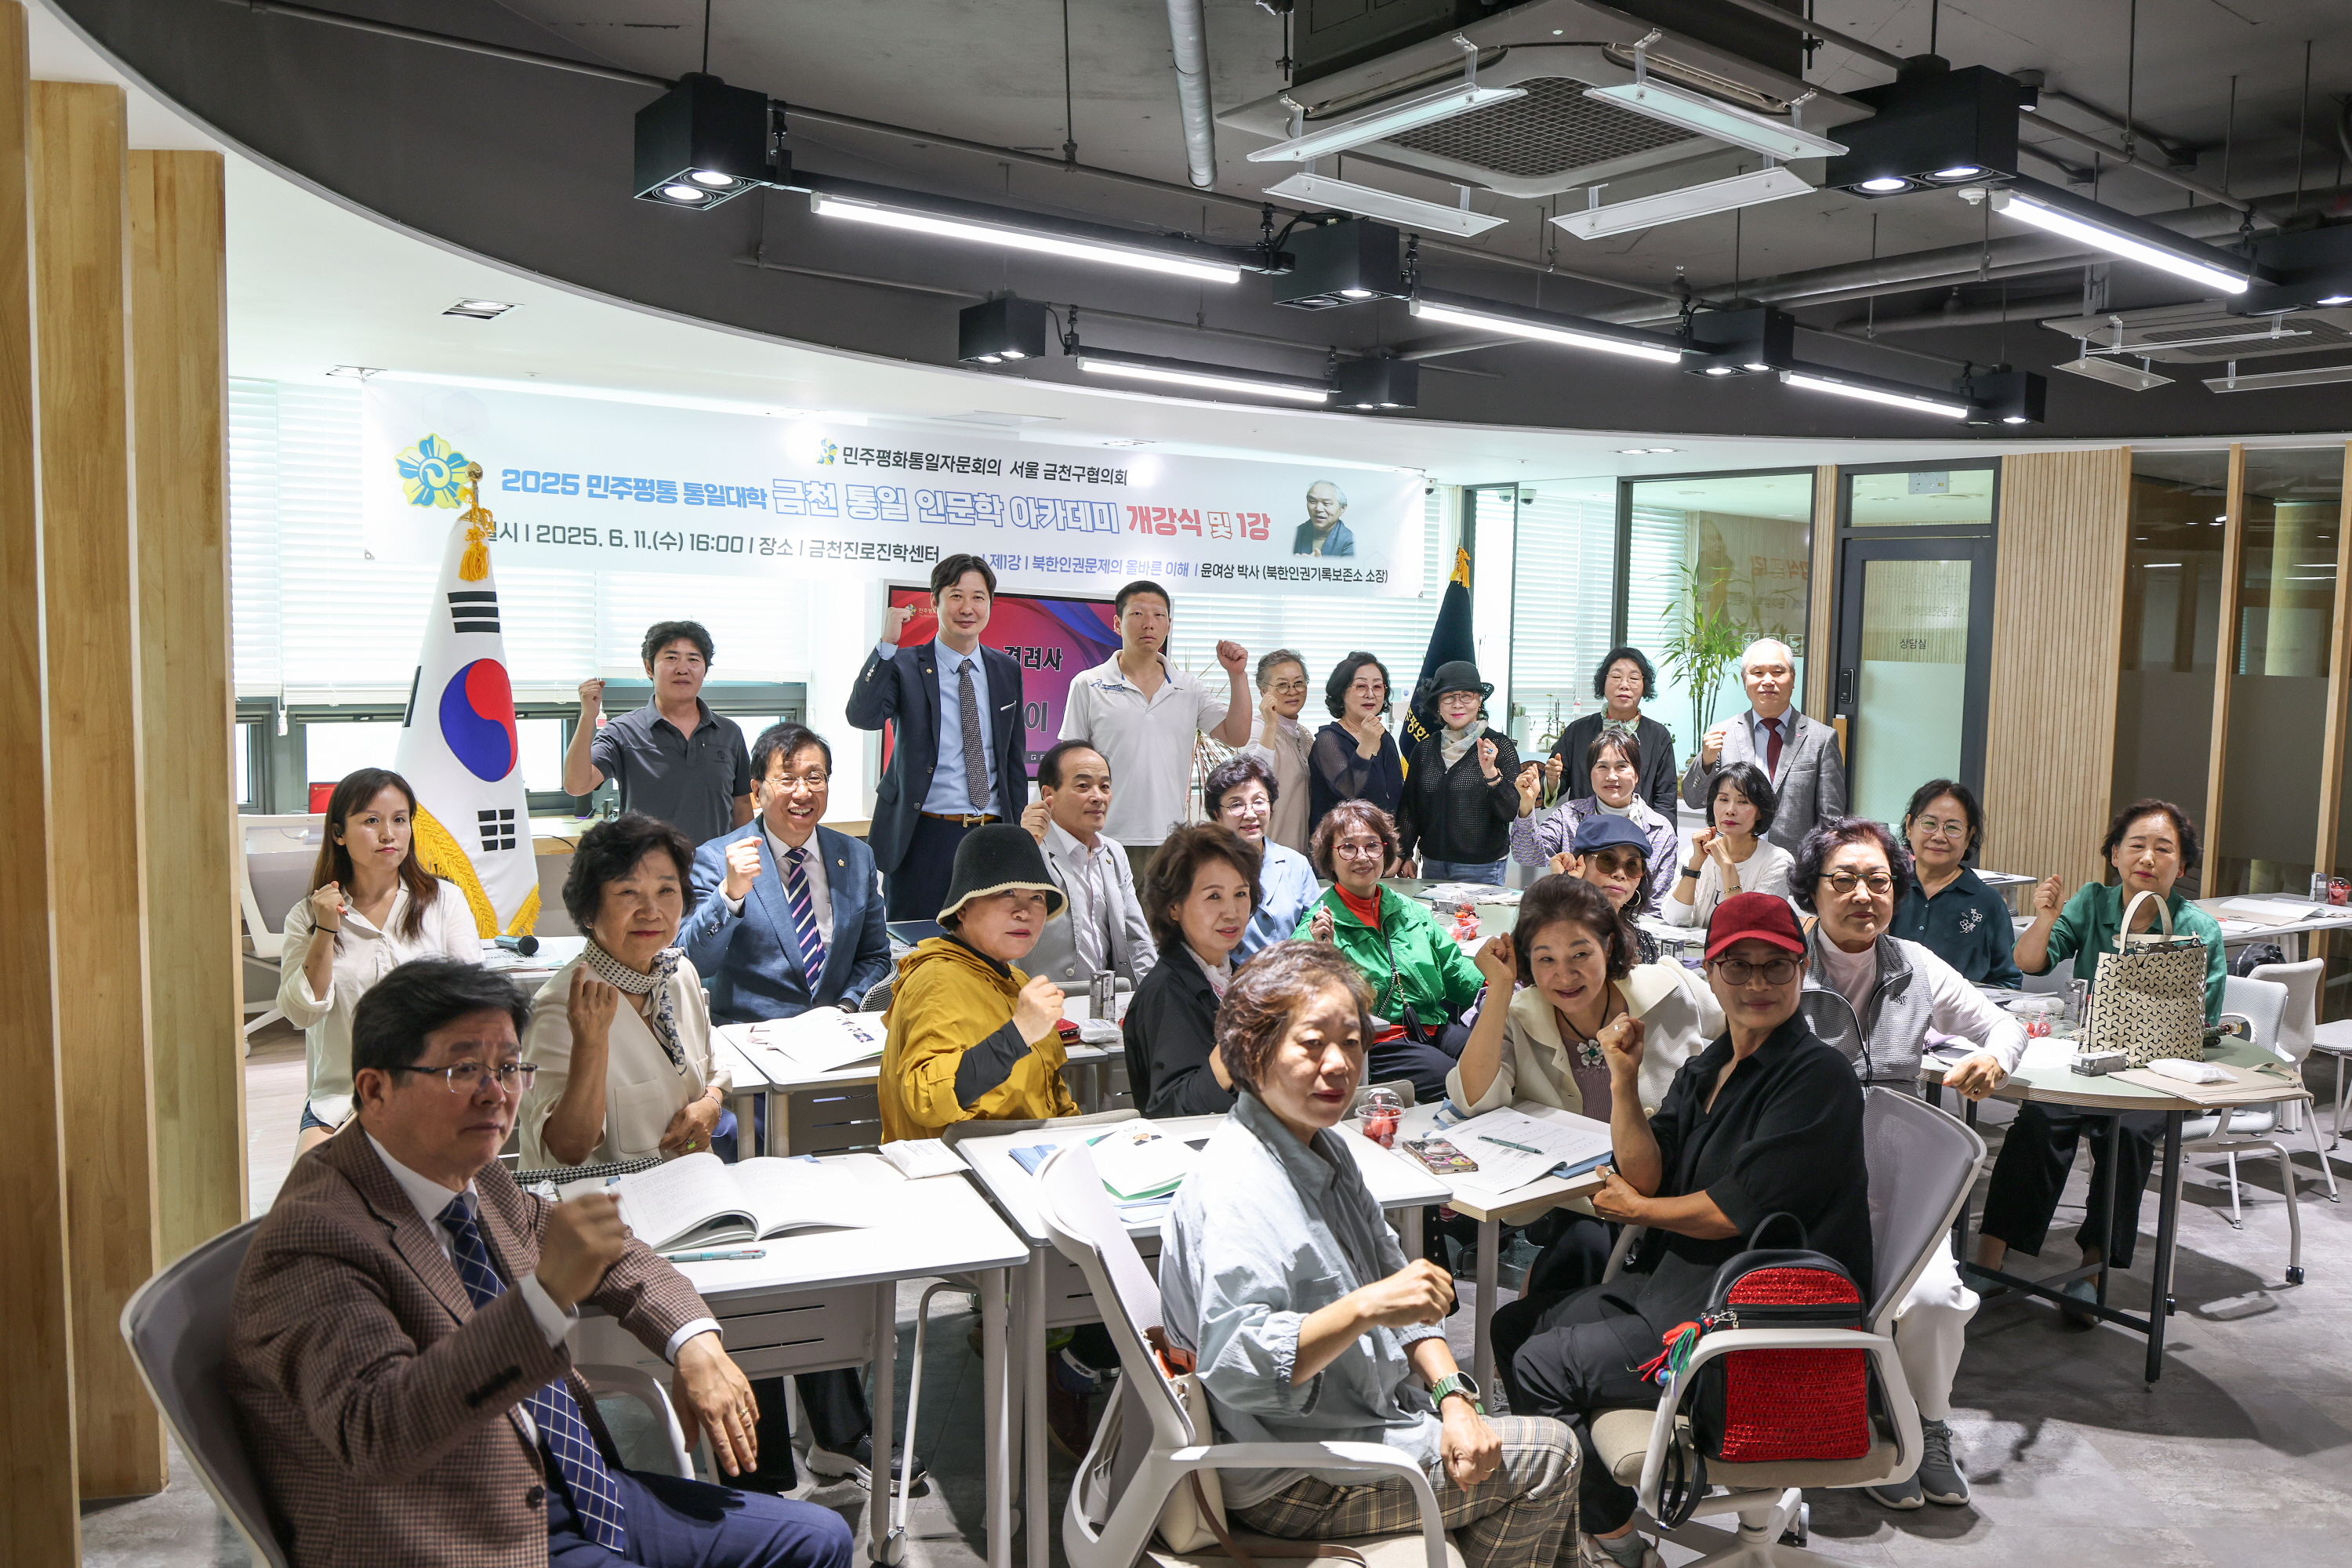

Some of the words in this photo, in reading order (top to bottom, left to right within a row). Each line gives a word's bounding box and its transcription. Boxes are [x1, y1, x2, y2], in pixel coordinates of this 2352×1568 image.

[843, 446, 1002, 476] 민주평화통일자문회의
[1009, 460, 1040, 479] 서울
[1043, 463, 1128, 485] 금천구협의회
[502, 468, 580, 495] 2025
[586, 474, 678, 503] 민주평통
[683, 481, 768, 510] 통일대학
[772, 478, 840, 517] 금천
[845, 484, 909, 522] 통일
[914, 488, 1004, 528] 인문학
[1009, 495, 1120, 534] 아카데미
[1126, 505, 1203, 537] 개강식
[1207, 511, 1233, 540] 및
[1236, 512, 1271, 541] 1강
[536, 524, 603, 546] 2025.
[608, 528, 629, 548] 6.
[633, 530, 684, 551] 11.(수)
[689, 533, 744, 554] 16:00
[758, 537, 794, 556] 장소
[808, 539, 940, 564] 금천진로진학센터
[989, 553, 1022, 571] 제1강
[1032, 555, 1123, 575] 북한인권문제의
[1126, 559, 1163, 576] 올바른
[1165, 561, 1189, 577] 이해
[1200, 562, 1236, 579] 윤여상
[1237, 564, 1260, 579] 박사
[1262, 564, 1363, 583] (북한인권기록보존소
[1365, 568, 1388, 584] 소장)
[1900, 638, 1927, 650] 상담실
